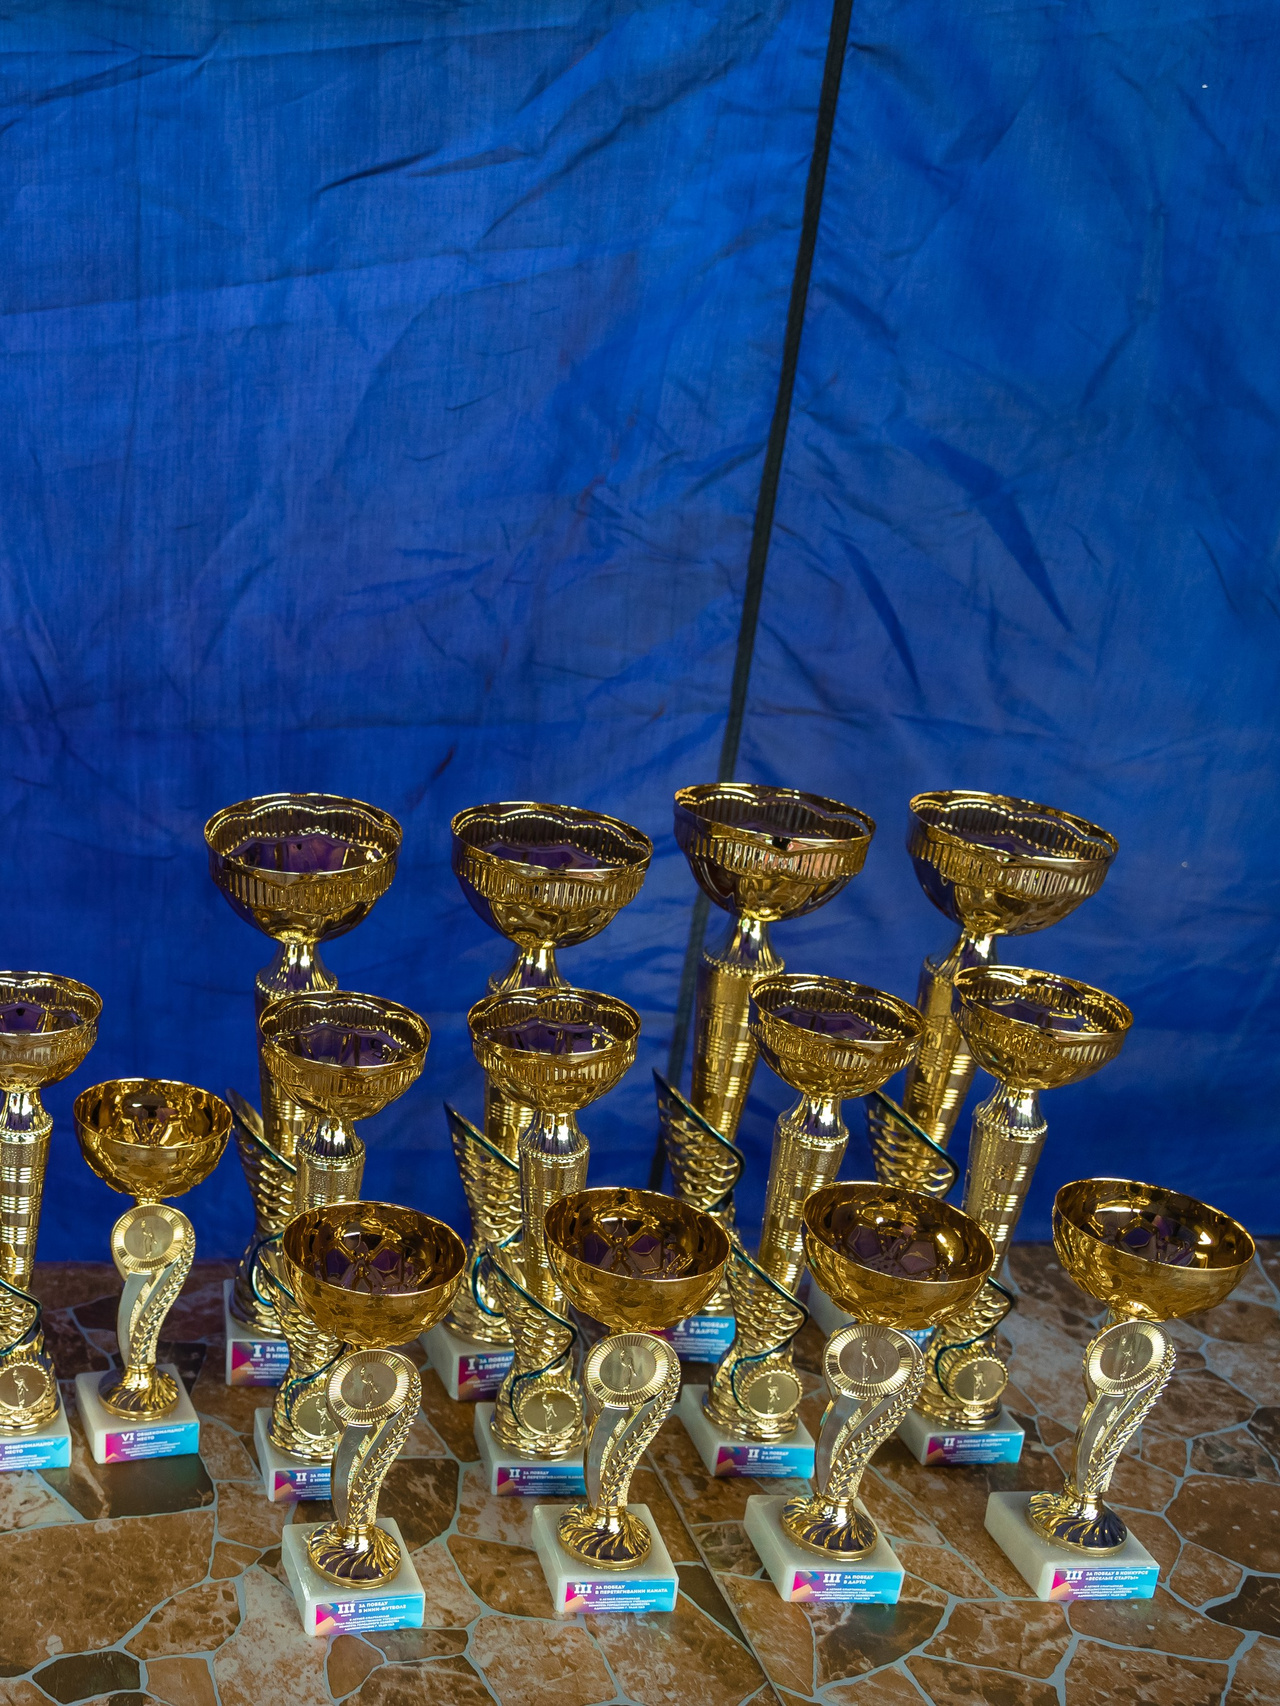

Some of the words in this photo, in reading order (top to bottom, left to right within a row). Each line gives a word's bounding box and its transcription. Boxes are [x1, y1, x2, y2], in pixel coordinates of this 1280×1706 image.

[253, 1345, 262, 1357] I
[468, 1359, 475, 1370] I
[121, 1433, 134, 1441] VI
[944, 1438, 955, 1446] II
[748, 1449, 759, 1458] II
[296, 1473, 306, 1481] II
[510, 1469, 520, 1477] II
[823, 1574, 841, 1583] III
[1065, 1571, 1083, 1580] III
[574, 1585, 592, 1593] III
[338, 1604, 355, 1614] III
[363, 1605, 406, 1613] МИНИ-ФУТБОЛЕ
